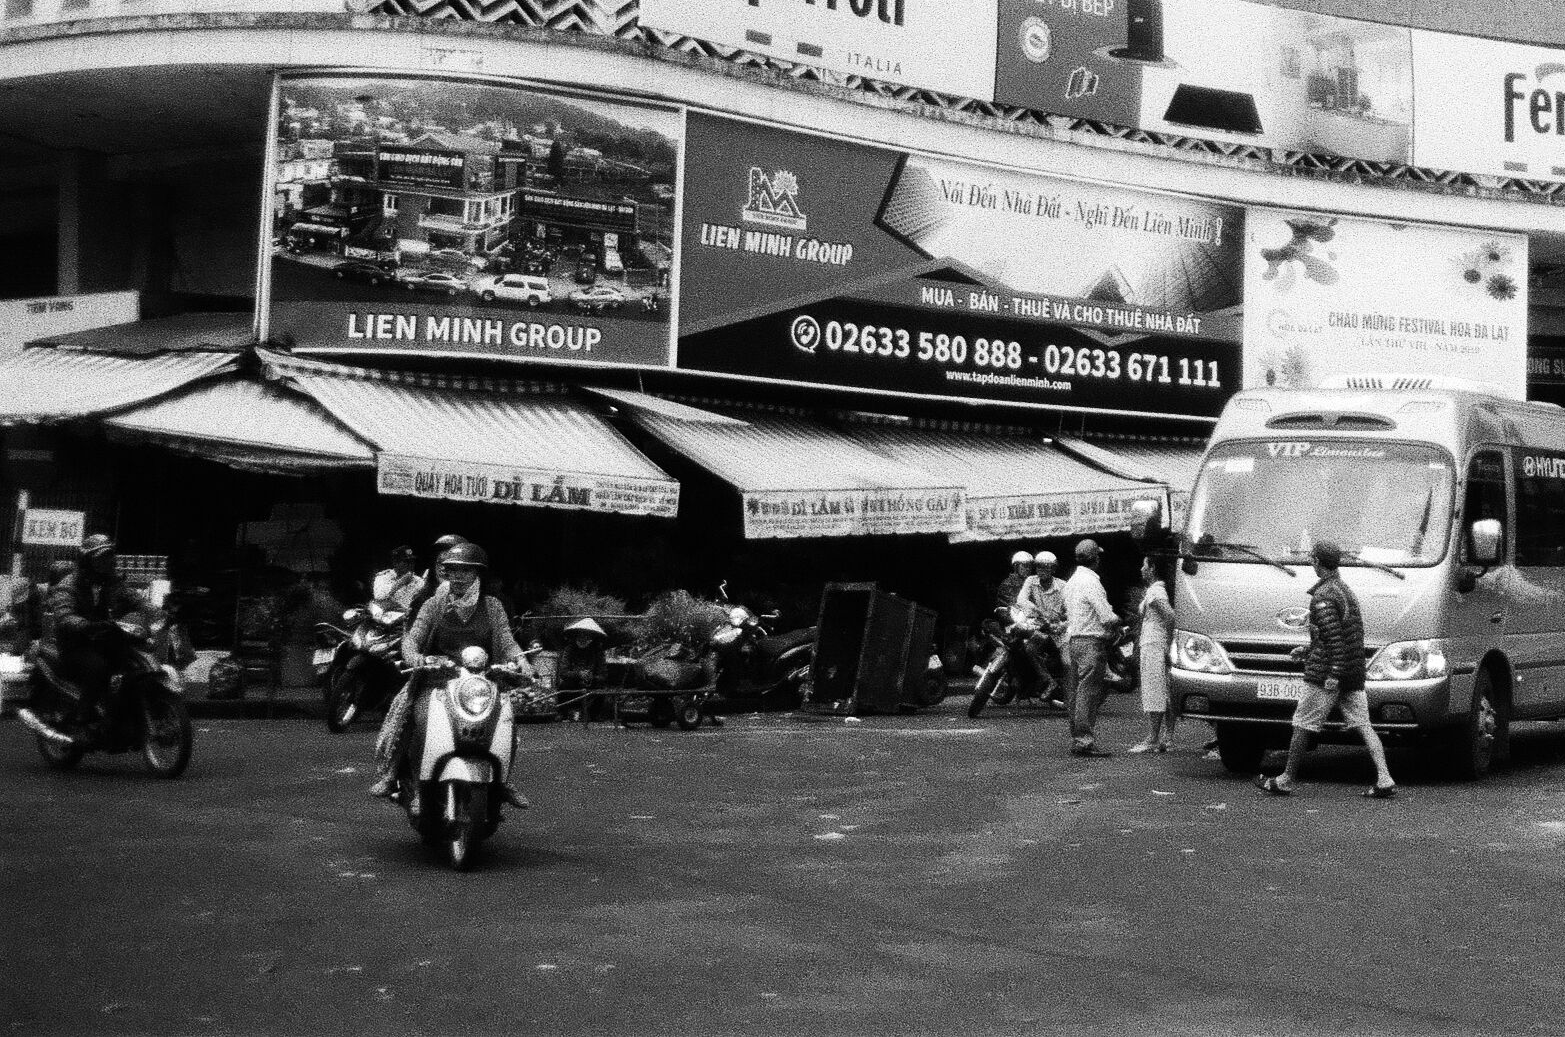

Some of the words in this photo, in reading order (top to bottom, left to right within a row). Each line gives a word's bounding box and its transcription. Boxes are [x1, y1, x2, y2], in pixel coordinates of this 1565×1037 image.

[847, 51, 902, 75] ITALIA
[700, 222, 742, 250] LIEN
[744, 230, 794, 258] MINH
[796, 238, 854, 265] GROUP
[922, 287, 955, 308] MUA
[969, 289, 998, 312] BÁN
[1013, 297, 1051, 318] THUÊ
[1053, 300, 1071, 320] VÀ
[1074, 304, 1102, 323] CHO
[1106, 308, 1142, 328] THUÊ
[1145, 311, 1174, 331] NHÀ
[1176, 313, 1202, 334] ĐẤT
[348, 312, 420, 343] LIEN
[426, 315, 502, 346] MINH
[510, 320, 602, 353] GROUP
[1398, 316, 1448, 336] FESTIVAL
[1450, 320, 1472, 339] HOA
[825, 321, 911, 358] 02633
[917, 332, 967, 363] 580
[974, 339, 1022, 369] 888
[1044, 345, 1120, 379] 02633
[1128, 353, 1171, 383] 671
[1179, 359, 1221, 387] 111
[946, 369, 1072, 391] www.tapdoanlienminh.com
[1268, 442, 1310, 457] VIP
[444, 472, 463, 495] HOA
